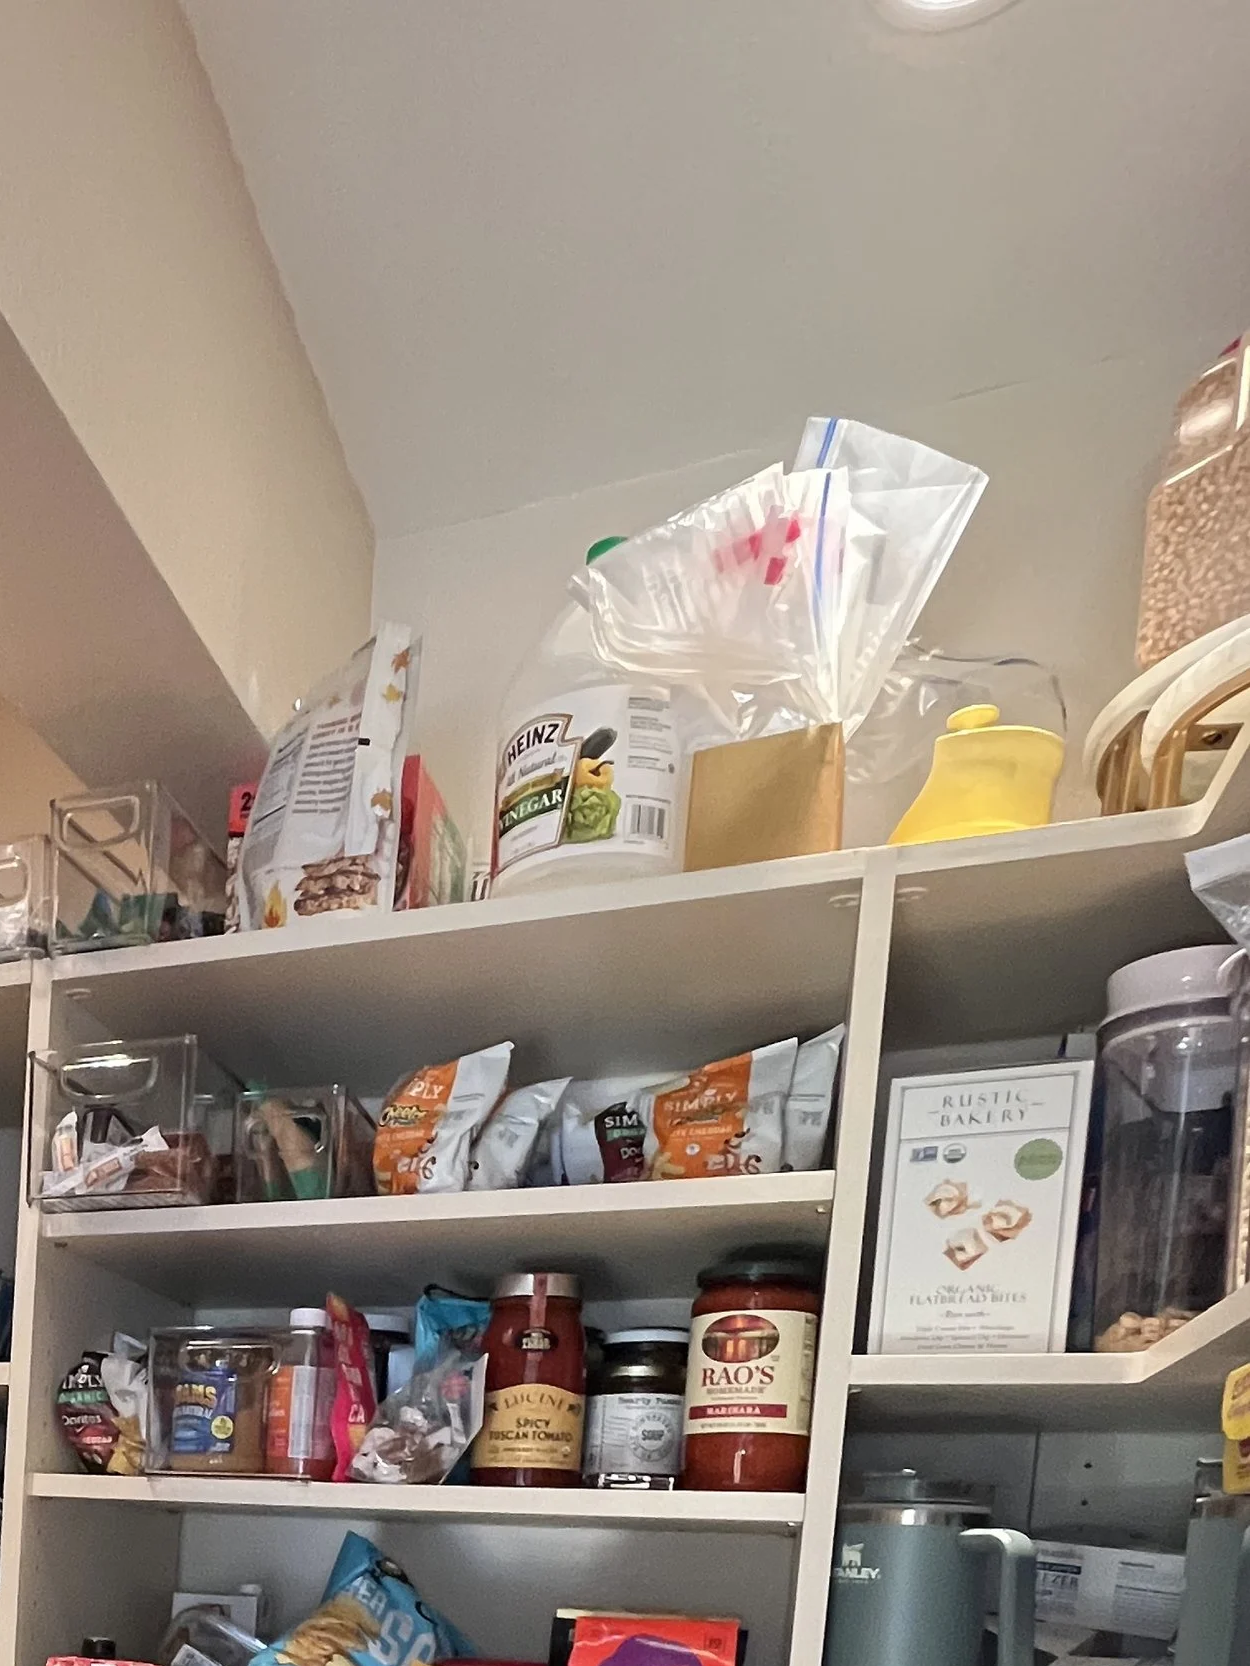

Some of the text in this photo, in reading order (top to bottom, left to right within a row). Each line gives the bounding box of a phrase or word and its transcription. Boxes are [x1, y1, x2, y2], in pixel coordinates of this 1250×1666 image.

[507, 723, 559, 766] HEINZ
[663, 1090, 737, 1113] SIMPLY
[942, 1089, 1027, 1109] RUSTIC
[604, 1113, 639, 1129] SIM
[939, 1109, 1025, 1128] BAKERY
[701, 1365, 775, 1388] RAO'S
[706, 1406, 762, 1416] MARINARA
[62, 1415, 102, 1426] Doritos
[516, 1418, 550, 1430] SPICY
[490, 1430, 574, 1443] TUSCAN TOMATO
[834, 1567, 880, 1580] TANLEY
